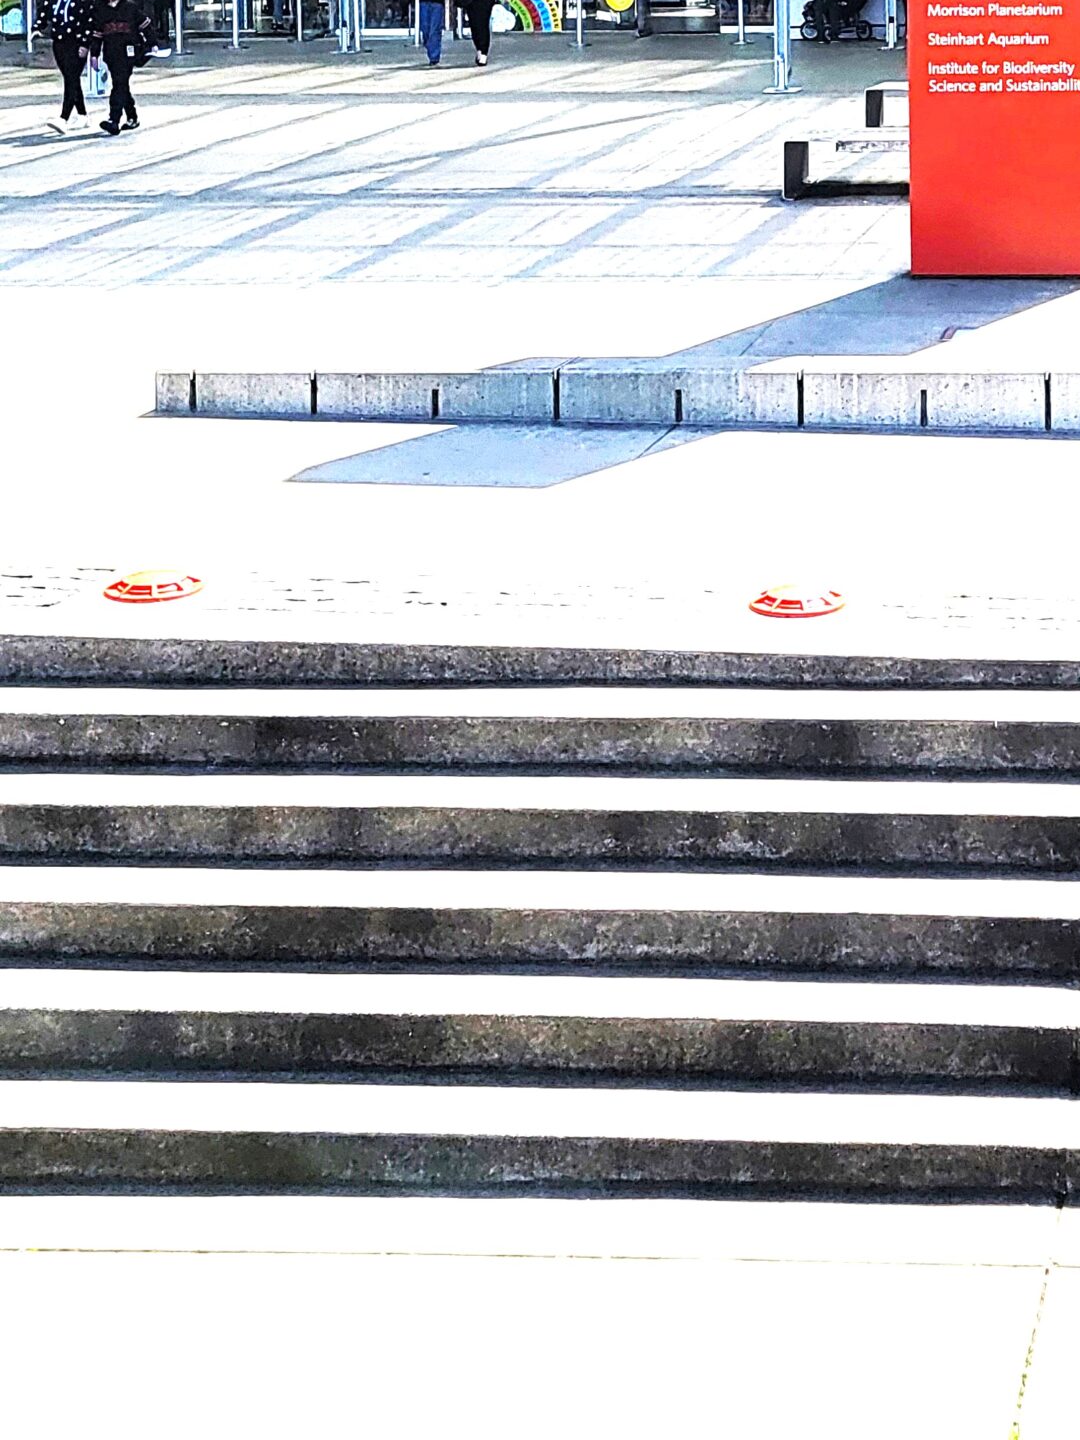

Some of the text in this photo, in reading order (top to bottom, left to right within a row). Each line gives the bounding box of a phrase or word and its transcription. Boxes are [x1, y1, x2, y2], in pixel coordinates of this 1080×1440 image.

[927, 3, 1063, 17] Morrison Planetarium
[927, 32, 1050, 48] Steinhart Aquarium
[927, 61, 1076, 77] Institute for Biodiversity
[928, 79, 977, 93] Science
[979, 78, 1003, 92] and
